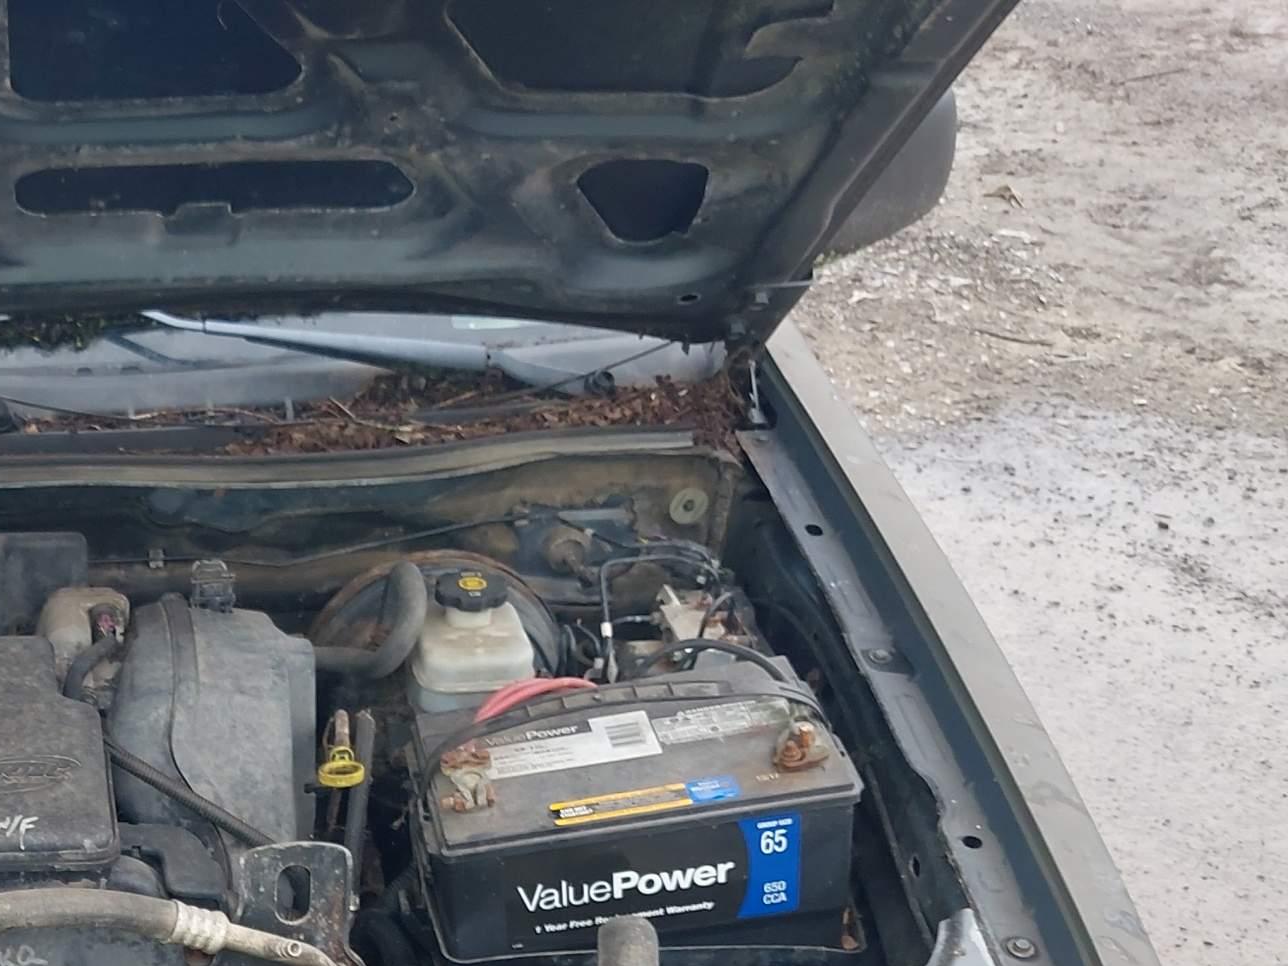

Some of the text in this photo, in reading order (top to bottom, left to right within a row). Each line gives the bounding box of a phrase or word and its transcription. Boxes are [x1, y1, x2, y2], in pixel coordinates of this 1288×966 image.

[760, 828, 788, 855] 65
[516, 861, 736, 913] ValuePower
[762, 892, 788, 905] CCA
[763, 880, 787, 893] 650
[543, 923, 568, 933] Year
[569, 919, 593, 929] Free
[665, 901, 716, 915] Warranty
